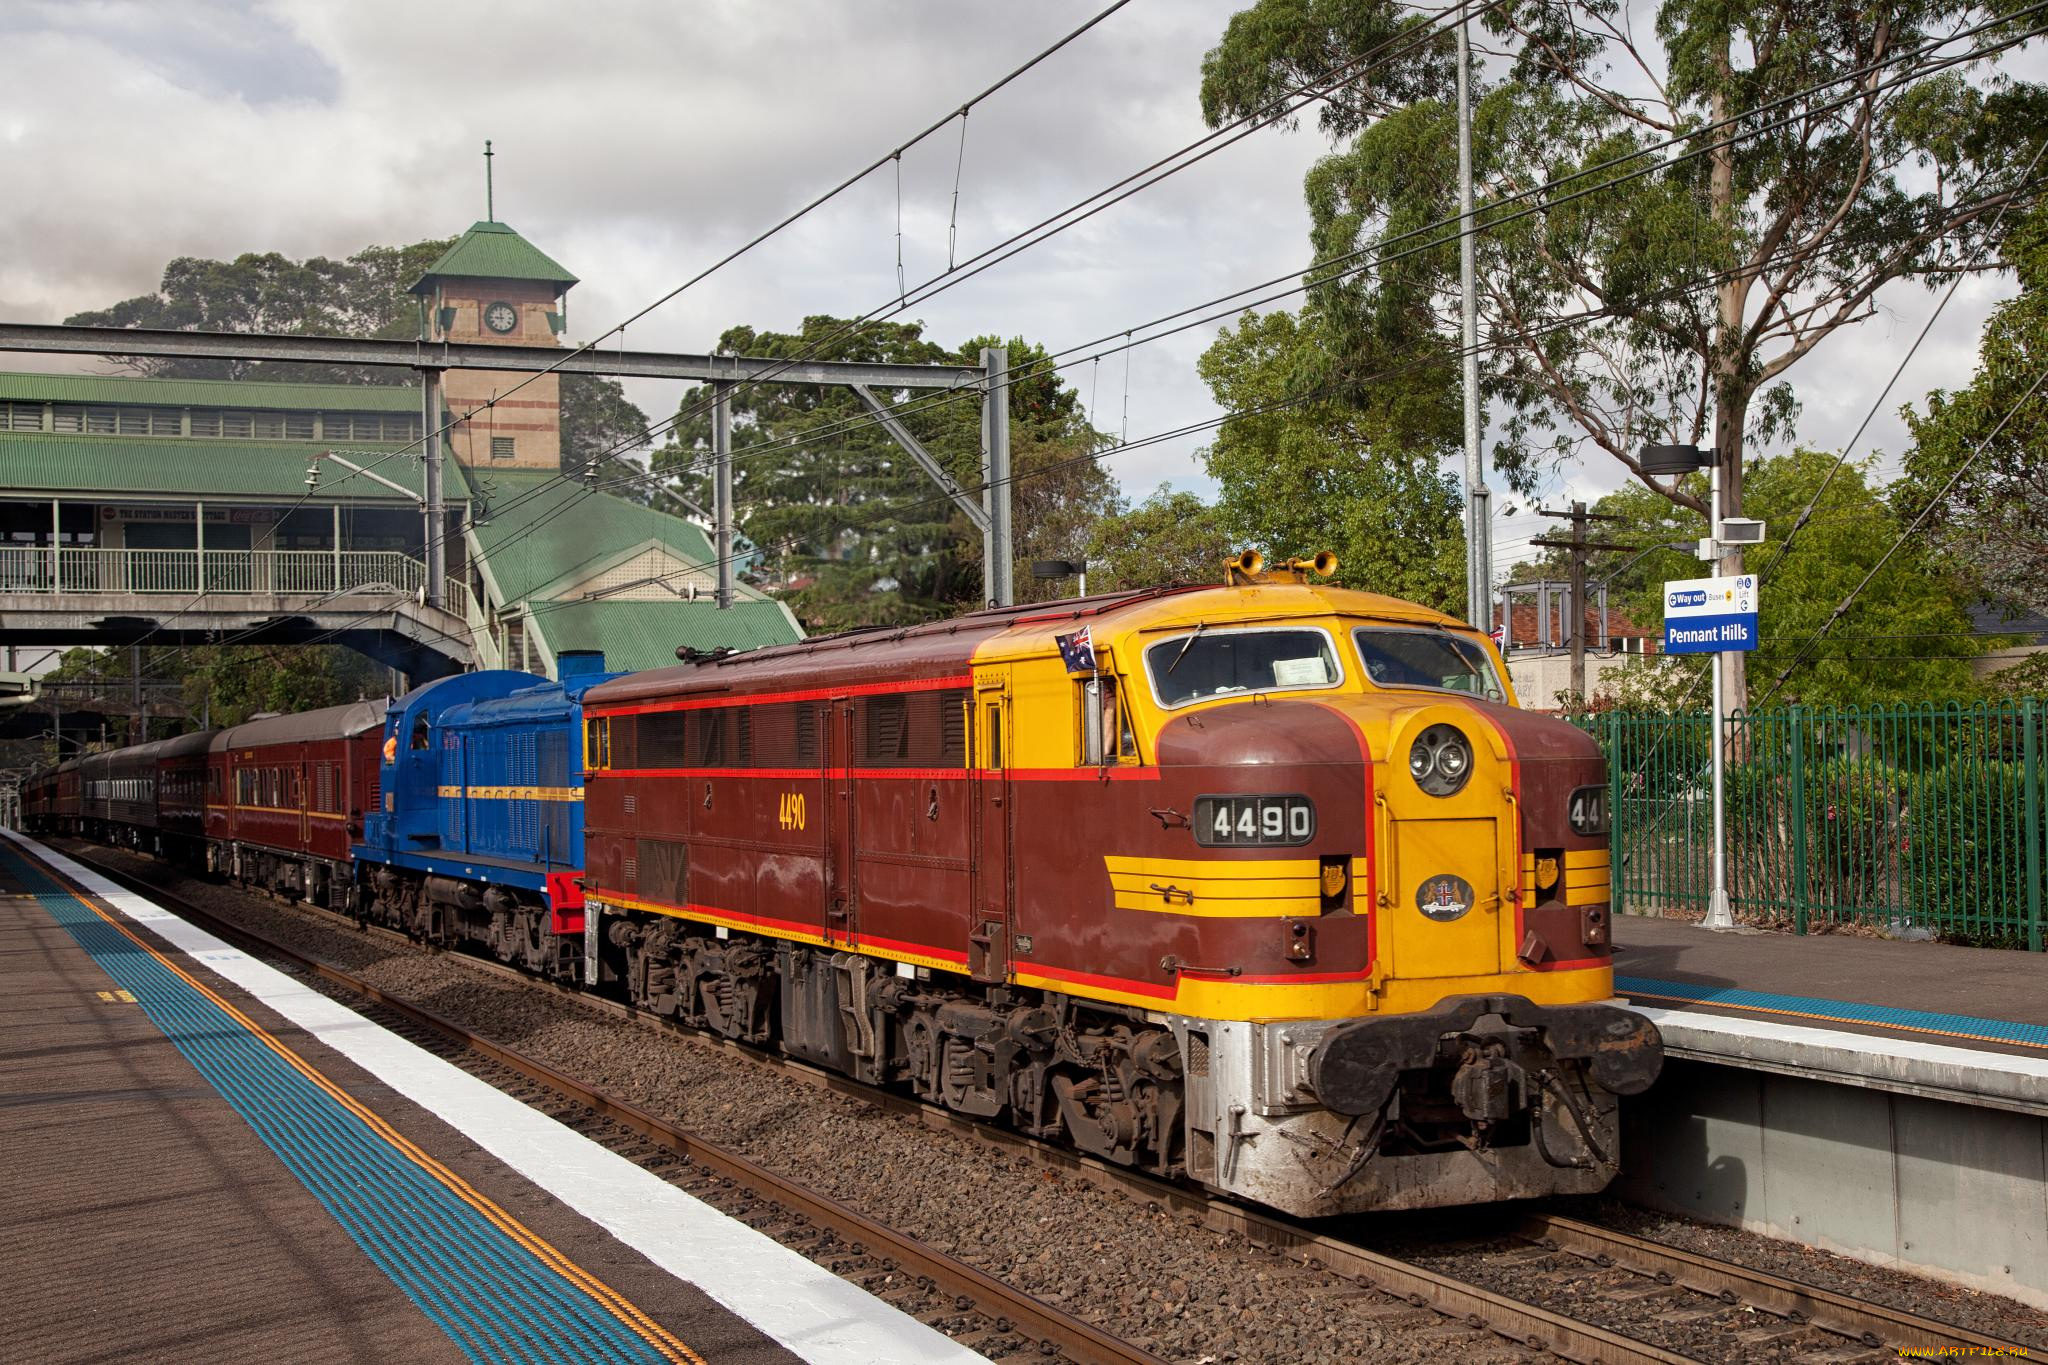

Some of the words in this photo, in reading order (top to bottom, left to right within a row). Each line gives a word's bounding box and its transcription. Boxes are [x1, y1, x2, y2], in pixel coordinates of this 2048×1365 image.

[119, 509, 133, 519] THE
[134, 509, 162, 519] STATION
[1677, 593, 1691, 604] Way
[1693, 592, 1705, 602] out
[1708, 593, 1724, 601] Buses
[1739, 590, 1749, 598] Lift
[1669, 627, 1718, 643] Pennant
[1721, 623, 1748, 640] Hills
[779, 793, 805, 830] 4490
[1214, 806, 1310, 837] 4490
